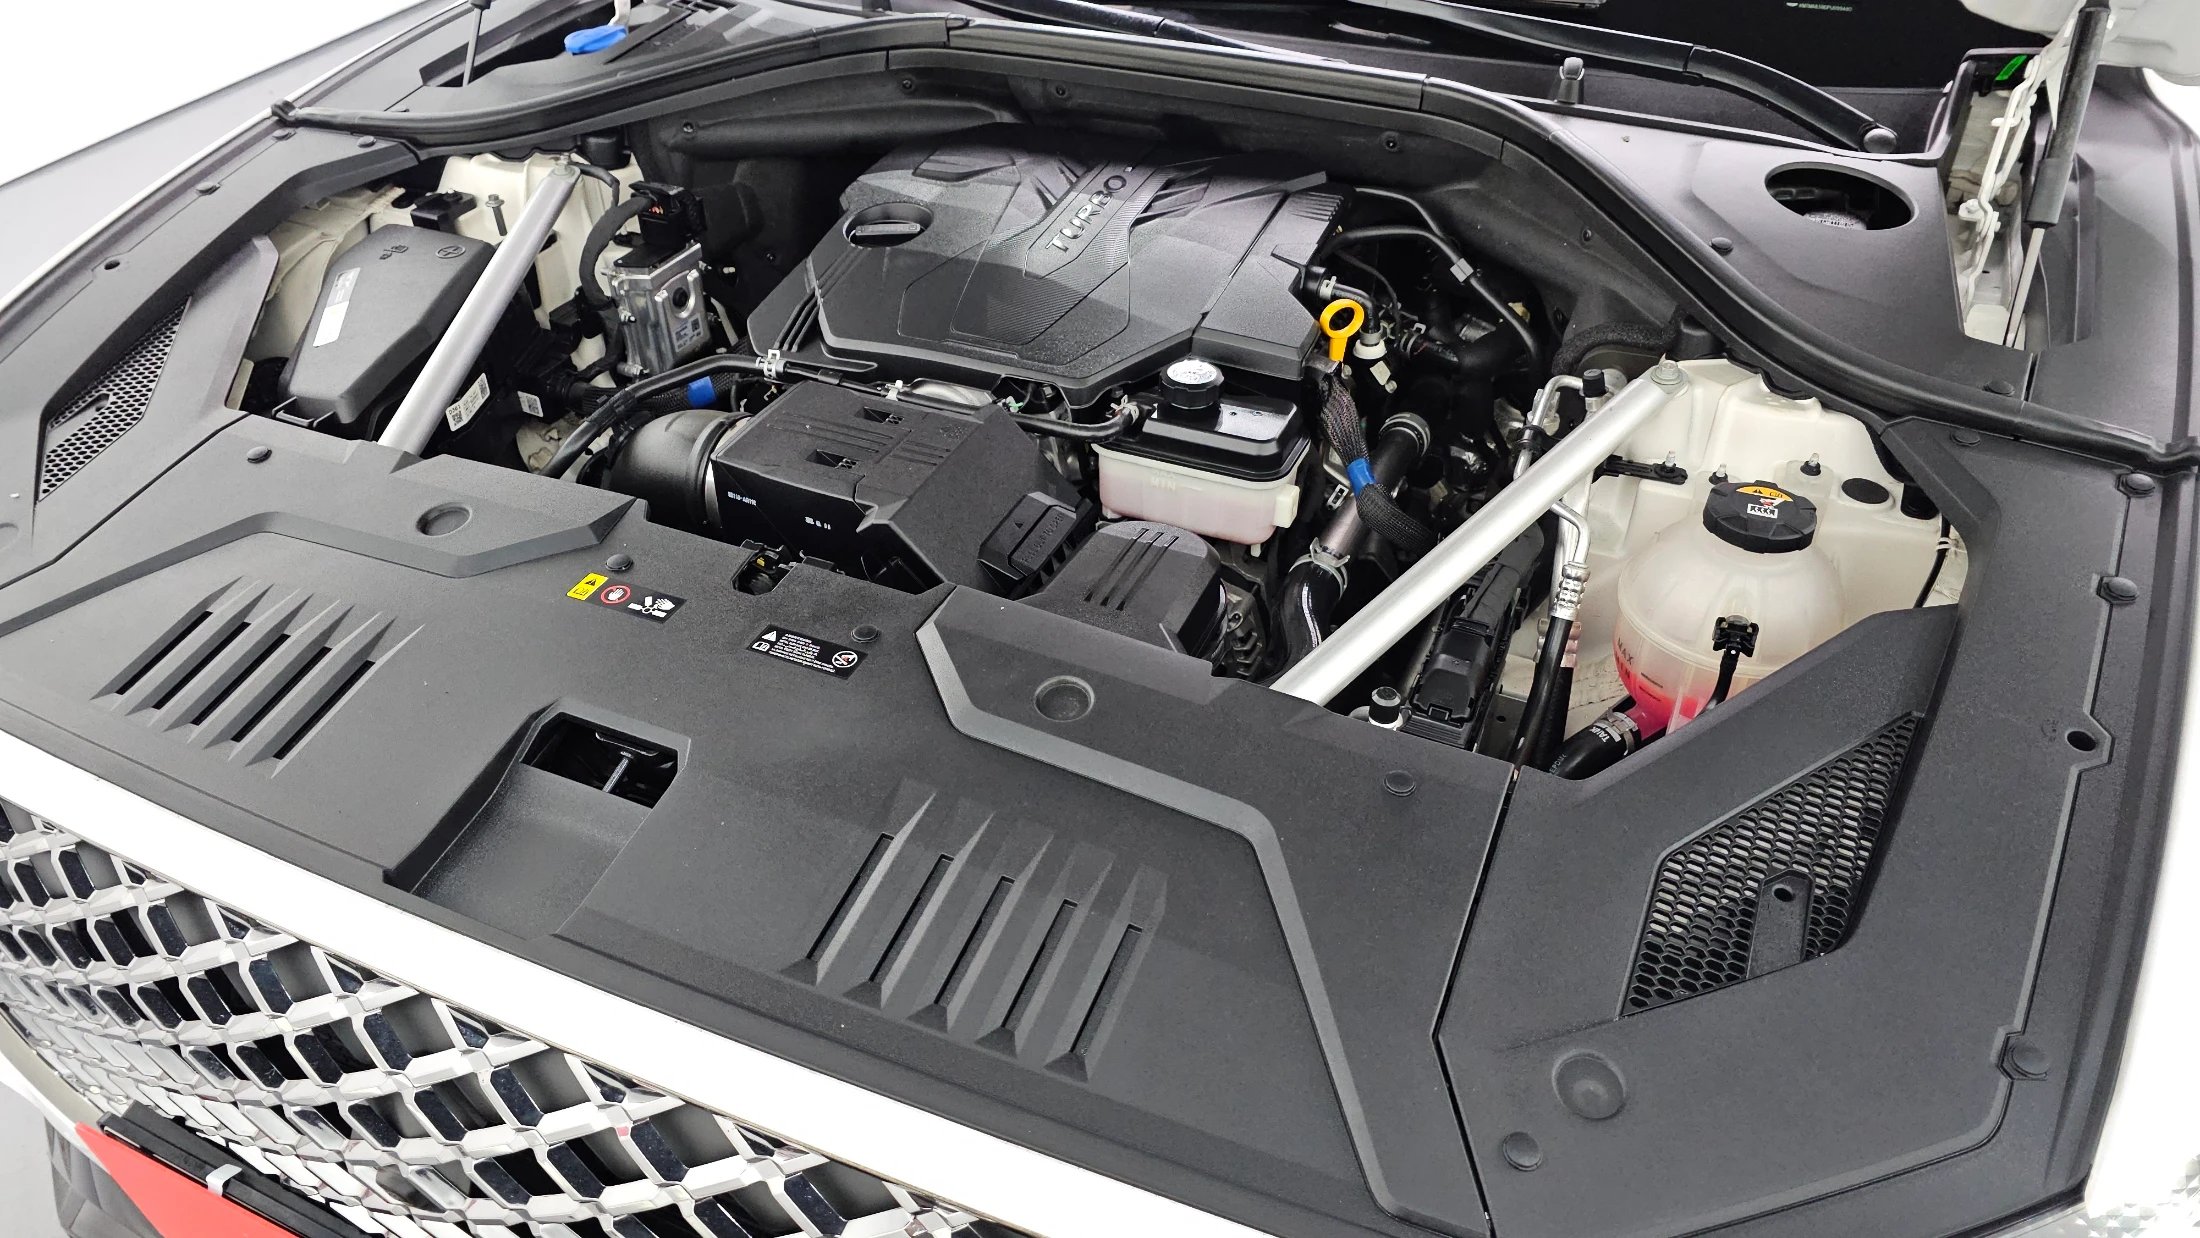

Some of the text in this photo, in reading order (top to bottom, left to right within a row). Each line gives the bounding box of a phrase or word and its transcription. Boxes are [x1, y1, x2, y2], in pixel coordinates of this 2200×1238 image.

[1045, 175, 1127, 253] TURBO
[1151, 476, 1176, 491] MIN
[1618, 638, 1634, 665] MAX
[1589, 726, 1610, 743] TANK
